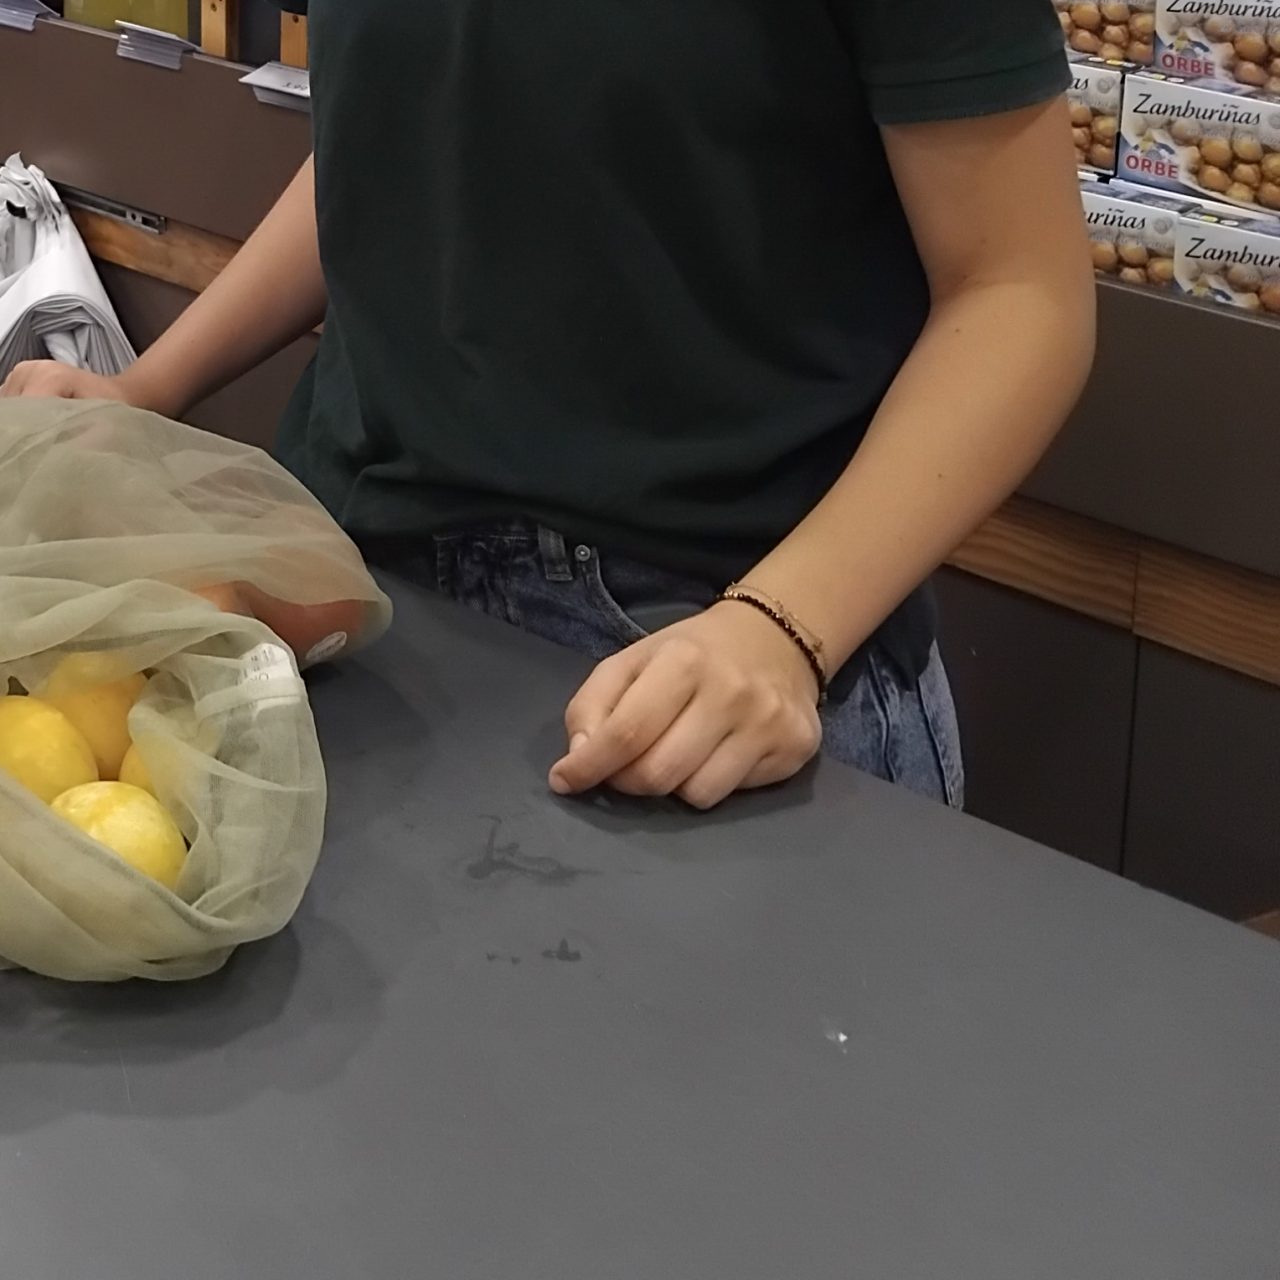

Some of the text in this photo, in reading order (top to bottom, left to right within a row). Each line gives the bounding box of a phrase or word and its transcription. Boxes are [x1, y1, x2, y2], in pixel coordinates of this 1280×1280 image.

[1161, 53, 1215, 77] ORBE
[1132, 92, 1262, 126] Zamburiñas
[1125, 154, 1180, 179] ORBE
